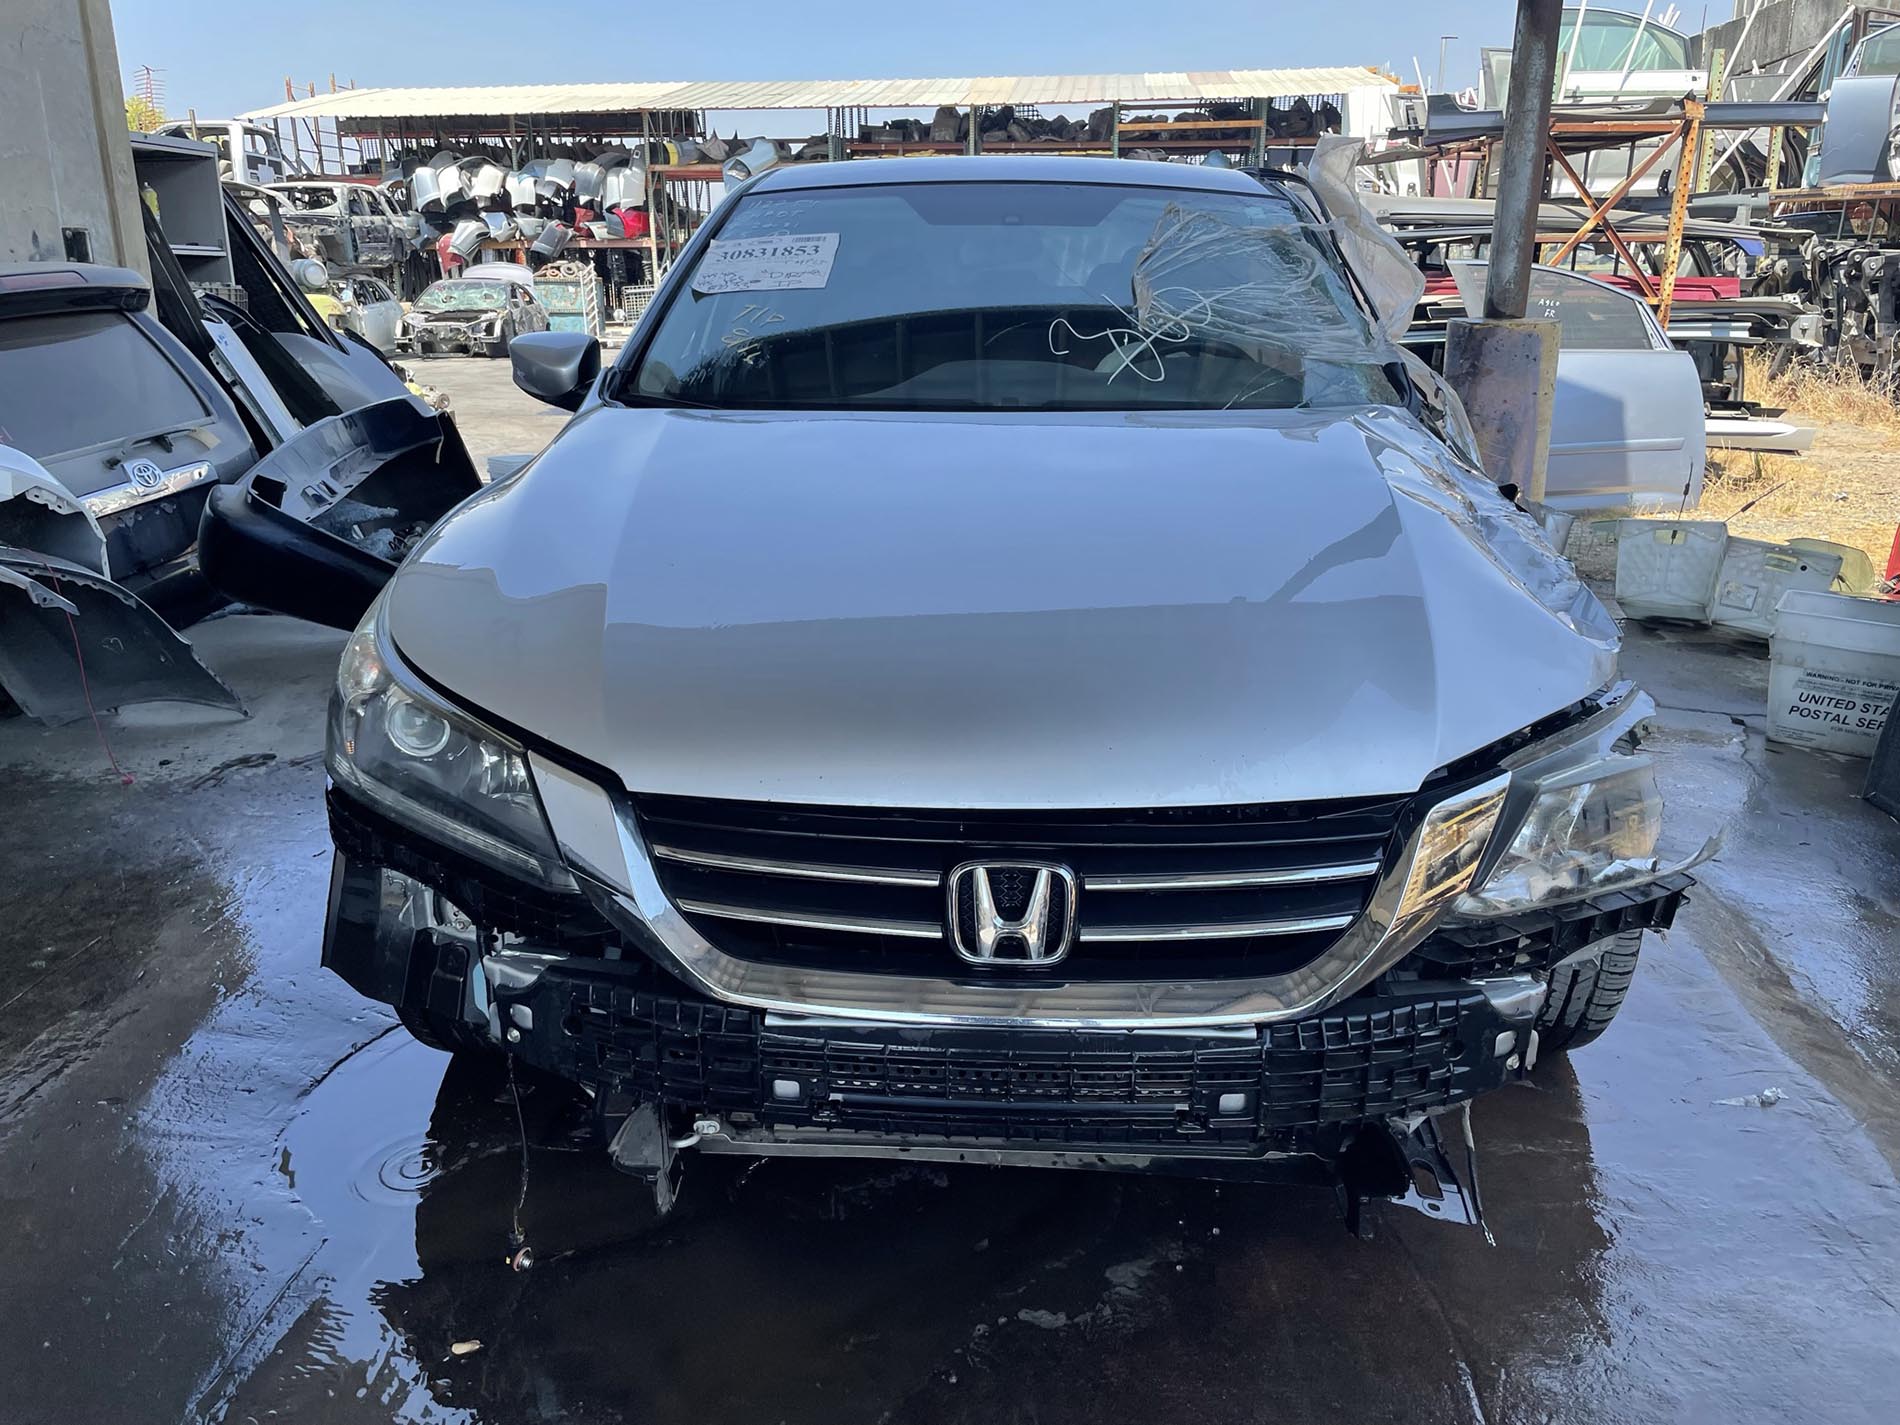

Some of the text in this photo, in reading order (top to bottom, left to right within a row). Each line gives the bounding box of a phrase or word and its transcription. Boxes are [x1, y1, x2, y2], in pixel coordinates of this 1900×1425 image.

[717, 245, 820, 262] 30831853
[1806, 671, 1840, 682] WARNING
[1845, 678, 1860, 686] NOT
[1799, 692, 1857, 711] UNITED
[1788, 705, 1850, 726] POSTAL
